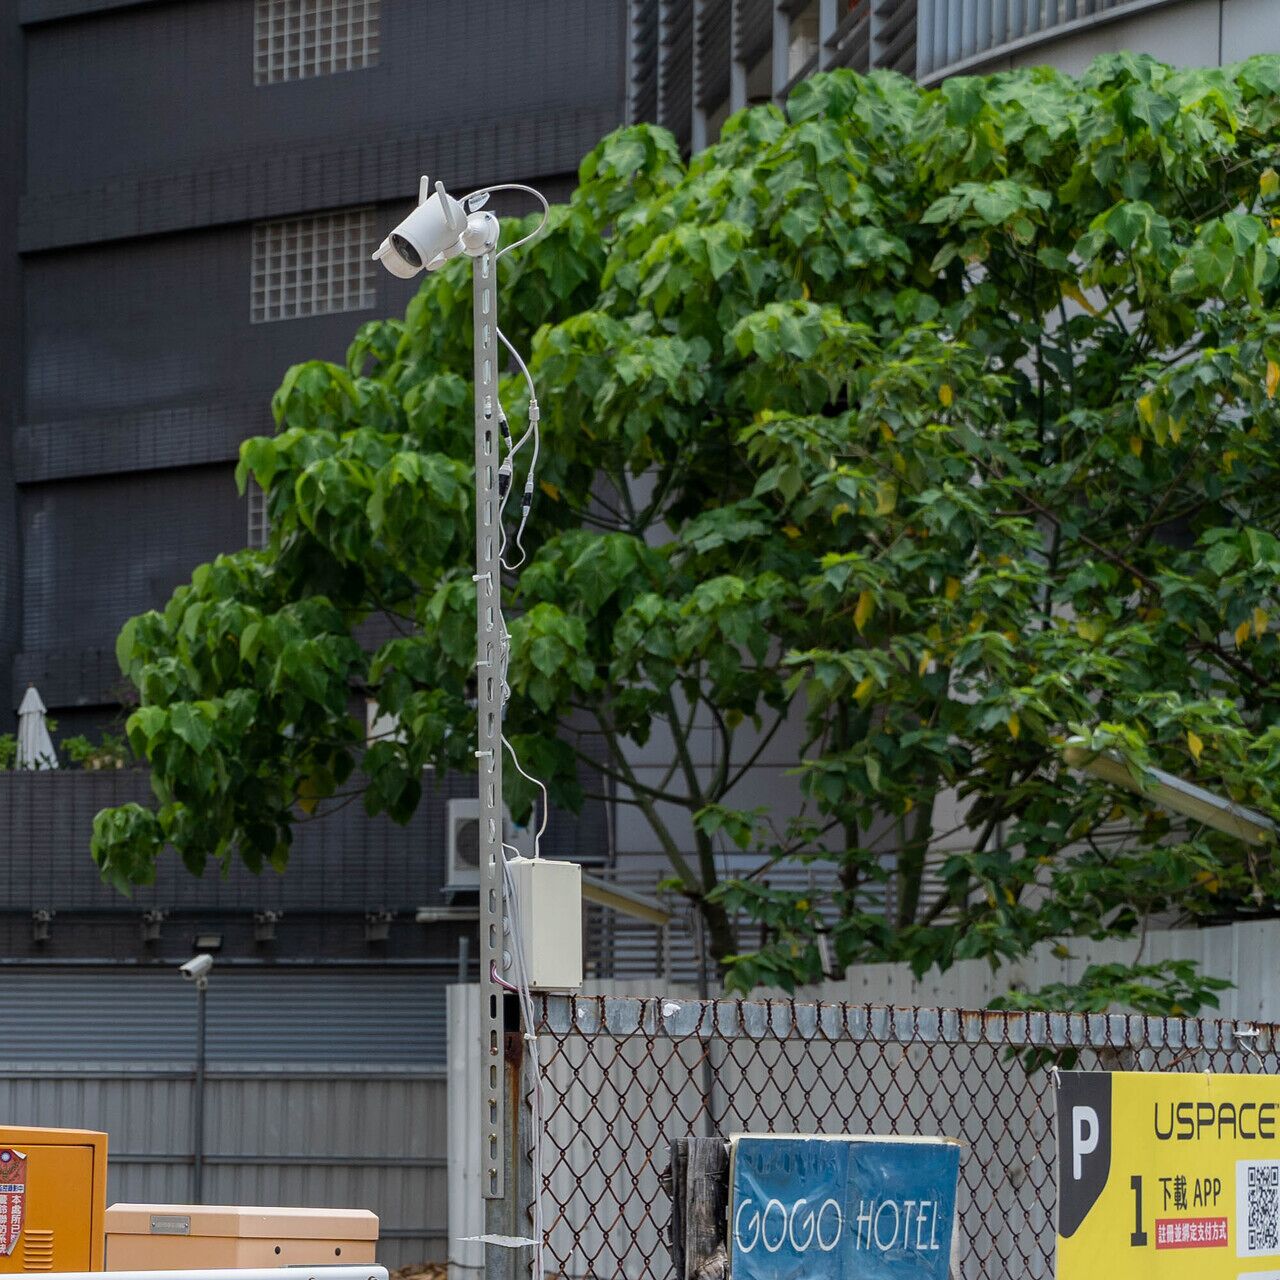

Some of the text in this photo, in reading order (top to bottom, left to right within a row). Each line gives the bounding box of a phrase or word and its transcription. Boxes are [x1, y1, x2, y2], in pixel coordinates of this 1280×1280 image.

[1072, 1105, 1099, 1180] P
[1130, 1175, 1148, 1247] 1
[1158, 1175, 1221, 1211] 下載 APP
[735, 1198, 940, 1253] GOGO HOTEL
